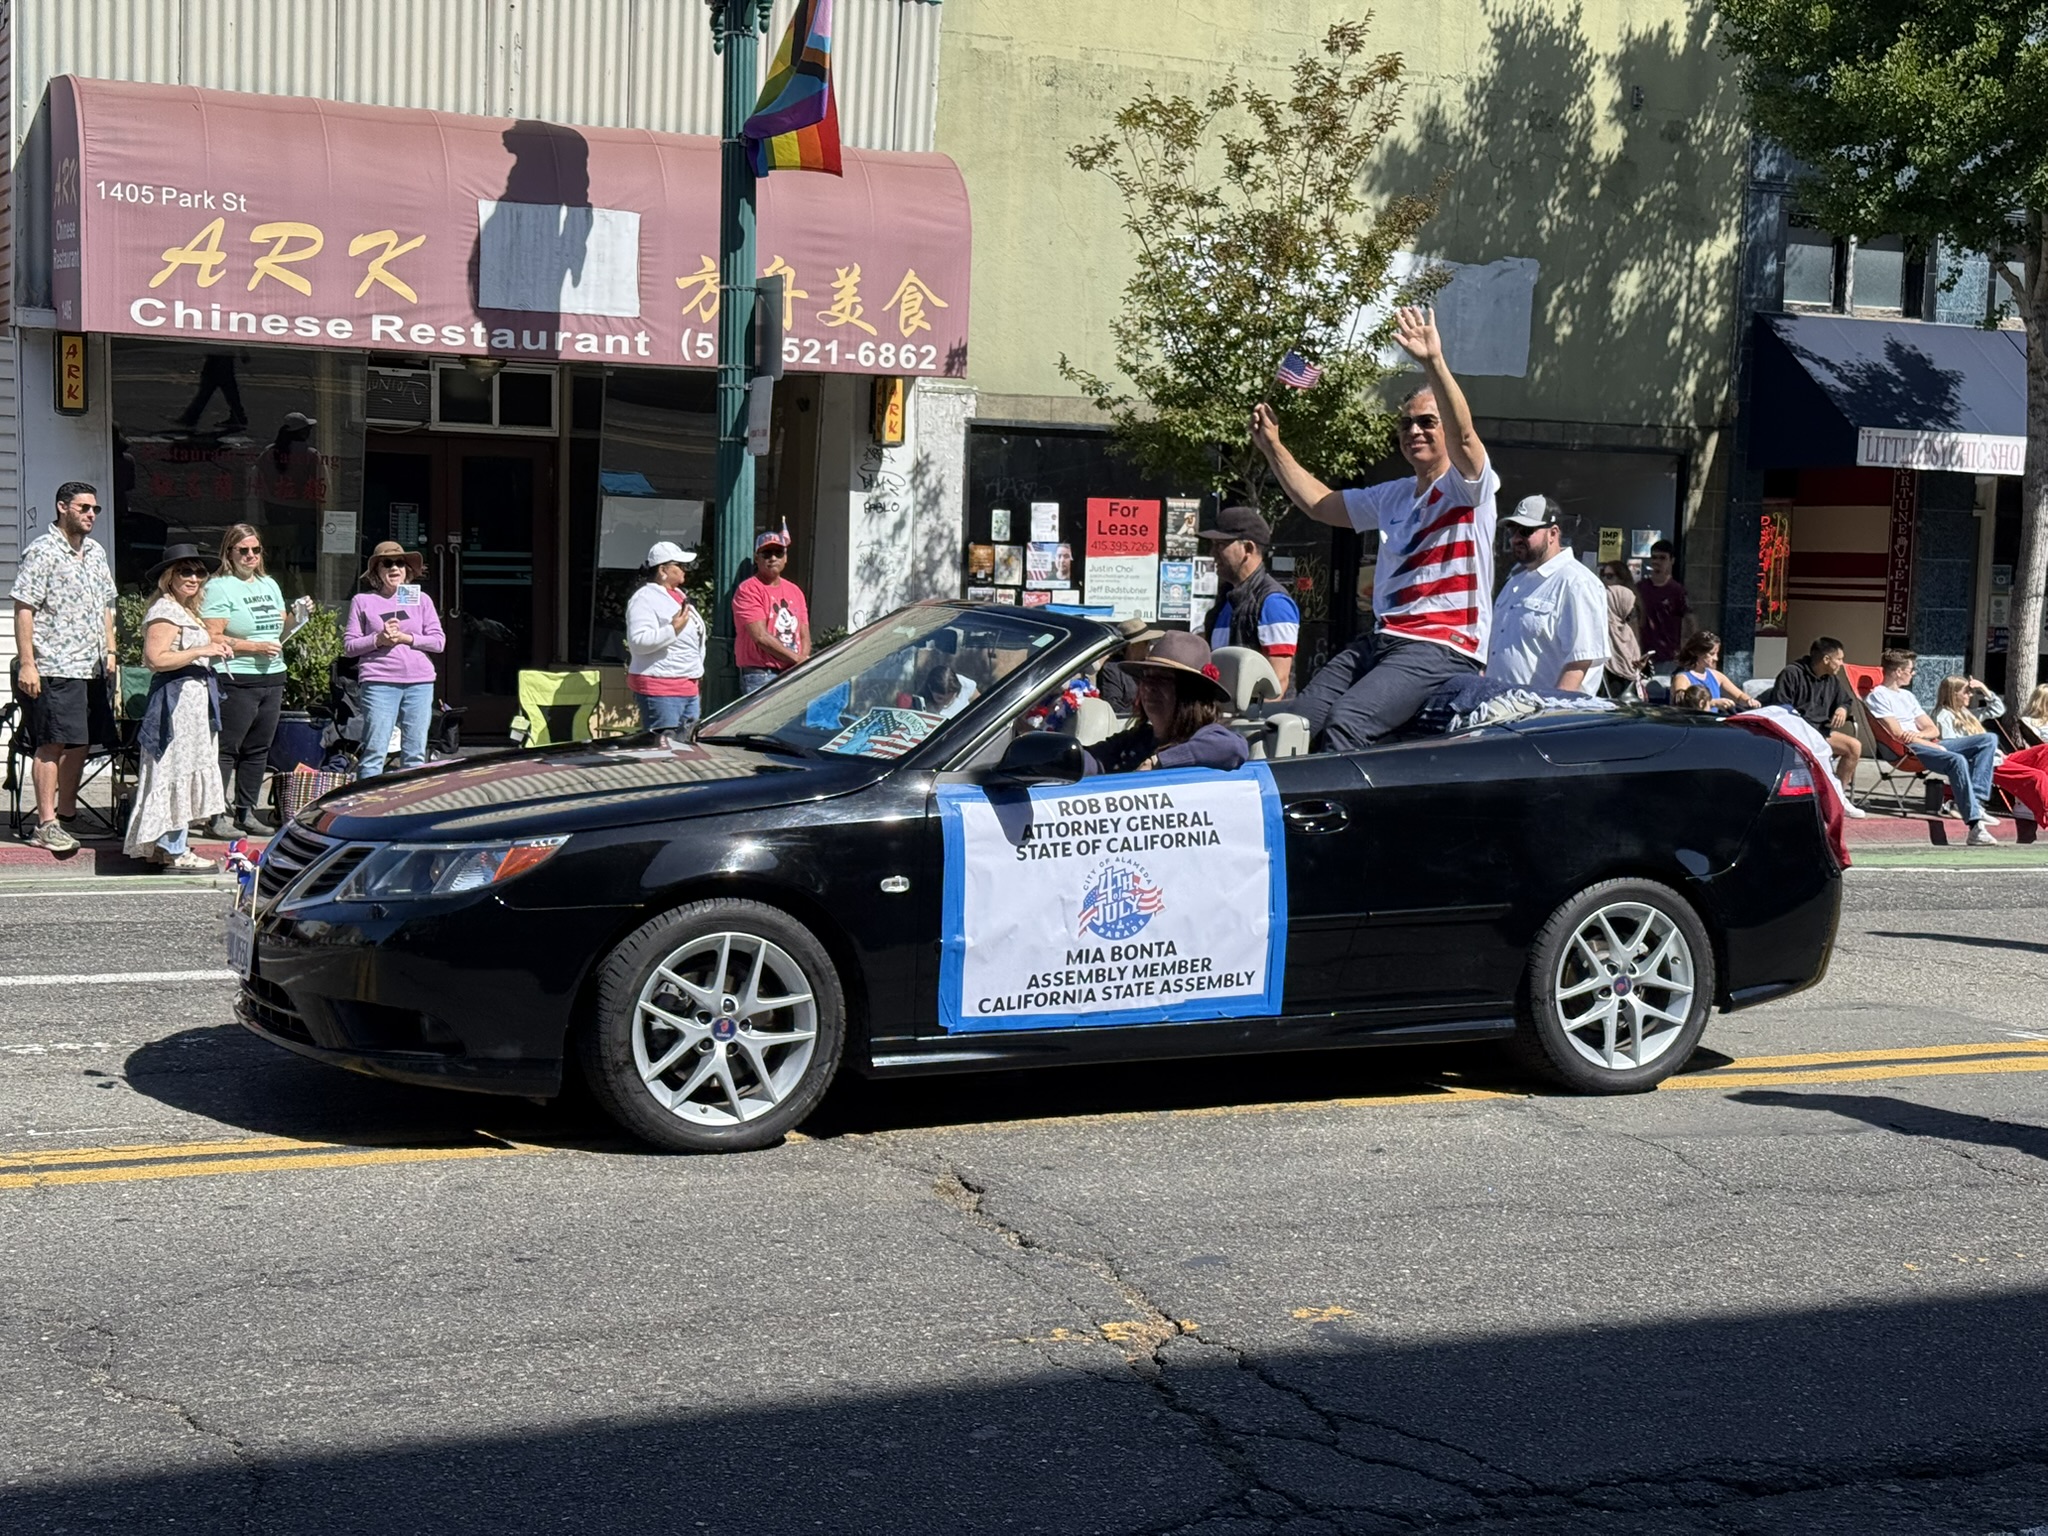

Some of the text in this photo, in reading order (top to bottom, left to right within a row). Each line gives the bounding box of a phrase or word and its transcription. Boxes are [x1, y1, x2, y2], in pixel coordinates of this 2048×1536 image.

[54, 157, 78, 209] ARK
[96, 181, 248, 213] 1405 Park St
[55, 219, 77, 241] Chinese
[53, 248, 80, 270] Restaurant
[148, 217, 427, 304] ARK
[129, 297, 353, 341] Chinese
[370, 313, 652, 358] Restaurant
[782, 336, 938, 370] 521-6862
[65, 343, 81, 400] ARK
[1865, 434, 1919, 465] LITTLE
[1923, 437, 1988, 469] PSYCHIC
[1109, 502, 1139, 518] For
[1097, 520, 1149, 536] Lease
[1602, 531, 1618, 539] IMP
[1090, 540, 1155, 552] 415.395.7262
[1089, 564, 1134, 573] Justin Choi
[1088, 585, 1103, 594] Jeff
[1891, 558, 1906, 625] TELLER
[1058, 792, 1174, 817] ROB BONTA
[1021, 811, 1214, 841] ATTORNEY GENERAL
[1016, 830, 1221, 861] STATE OF CALIFORNIA
[1083, 856, 1152, 891] CITY OF ALAMEDA
[1098, 866, 1134, 903] 4TH
[1092, 893, 1143, 926] JULY
[1098, 919, 1145, 938] PARADE
[1065, 940, 1178, 965] MIA BONTA
[1026, 957, 1213, 990] ASSEMBLY MEMBER
[978, 970, 1256, 1014] CALIFORNIA STATE ASSEMBLY
